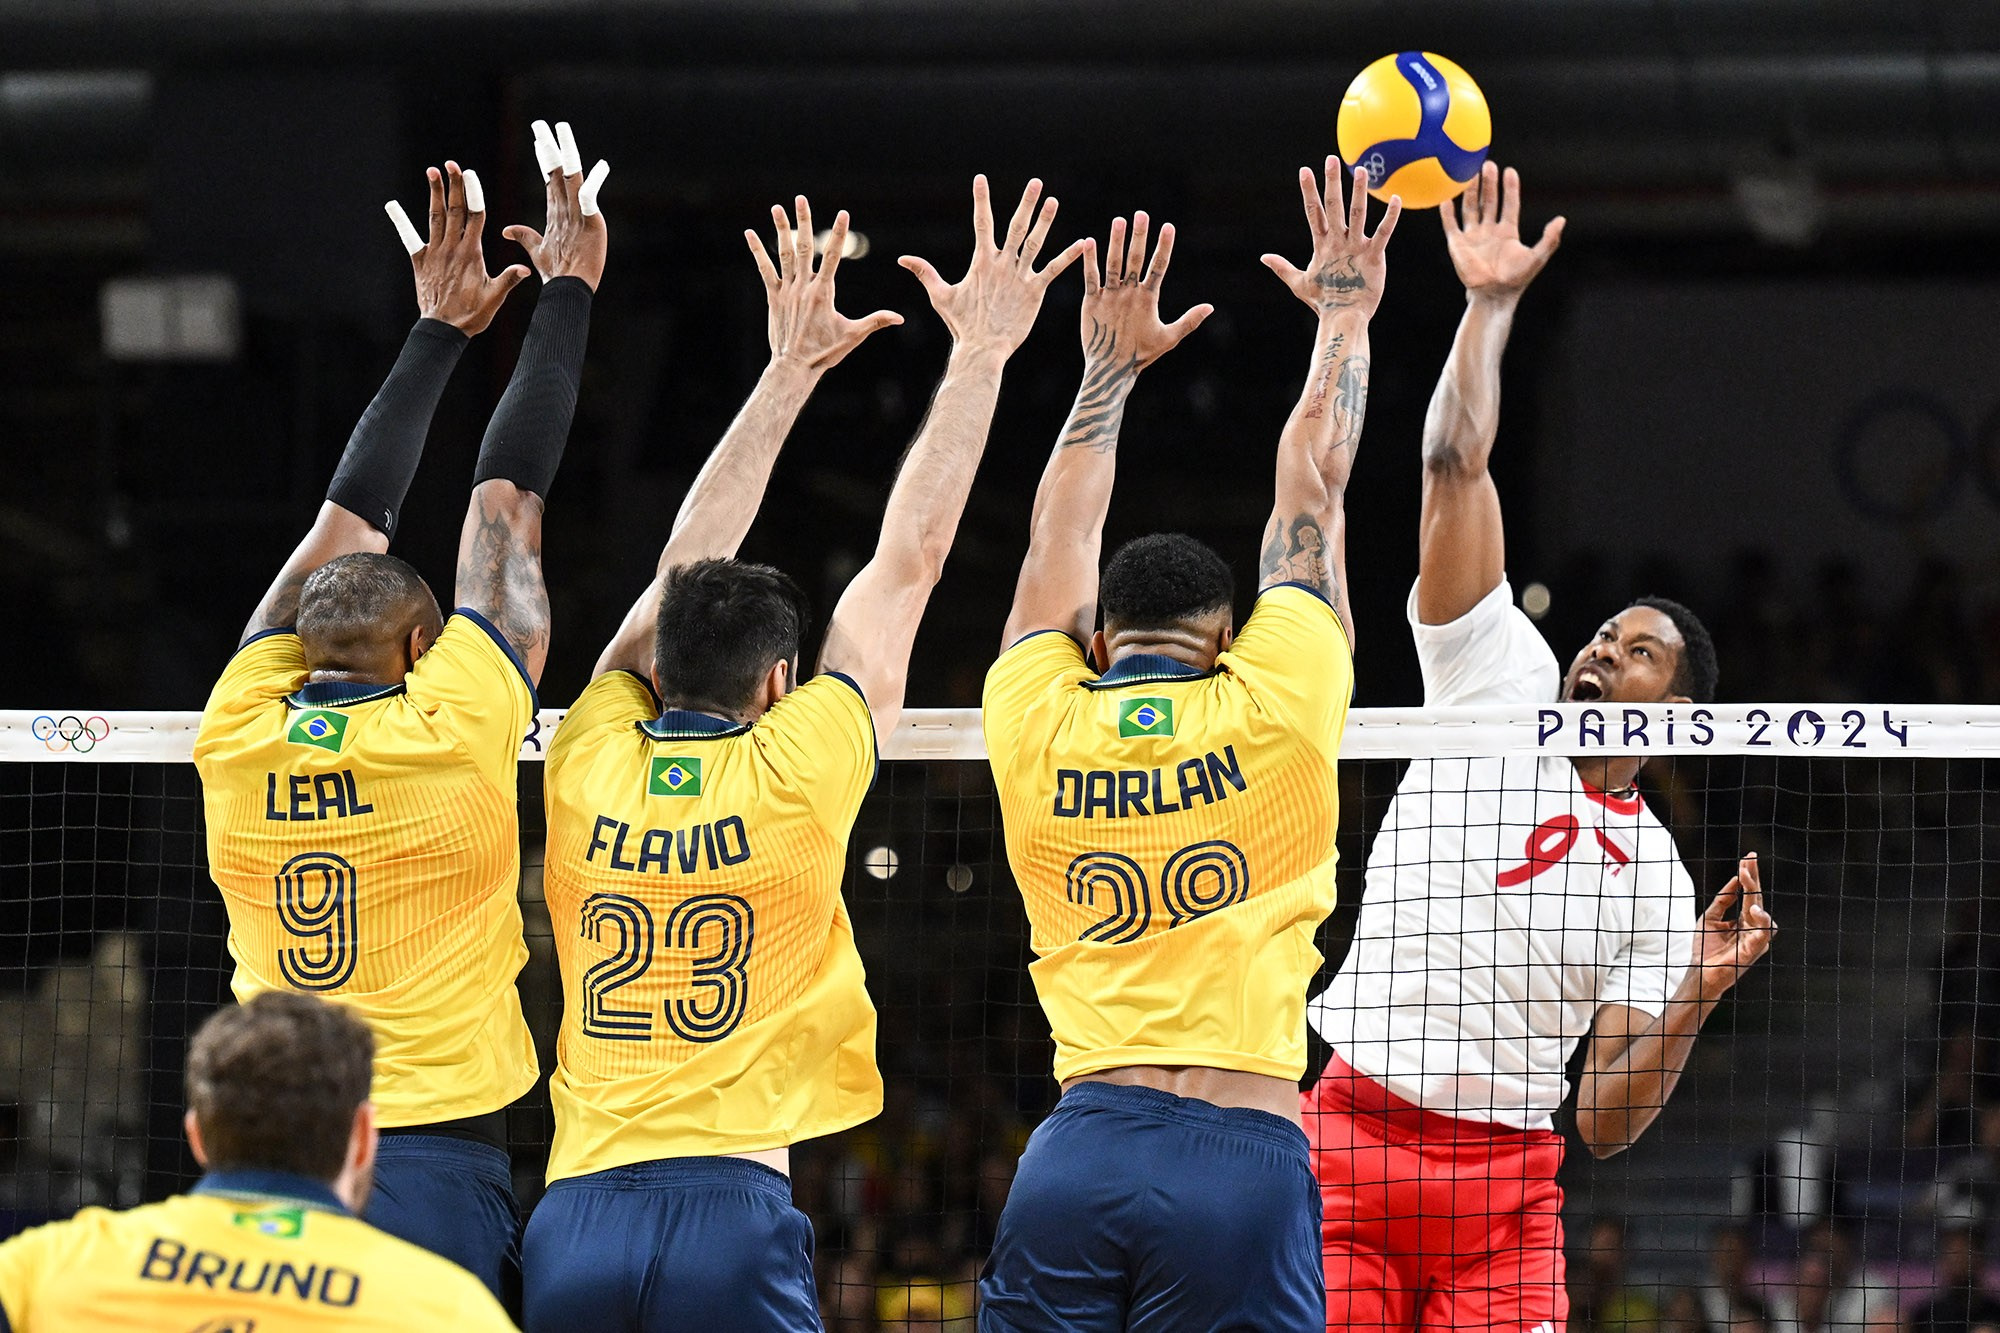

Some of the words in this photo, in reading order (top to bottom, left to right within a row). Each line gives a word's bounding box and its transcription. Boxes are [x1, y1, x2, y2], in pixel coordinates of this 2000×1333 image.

[266, 769, 374, 821] LEAL
[1053, 744, 1247, 819] DARLAN
[585, 814, 752, 874] FLAVIO
[1496, 813, 1580, 888] 9
[275, 851, 358, 991] 9
[580, 892, 755, 1043] 23
[139, 1236, 361, 1308] BRUNO
